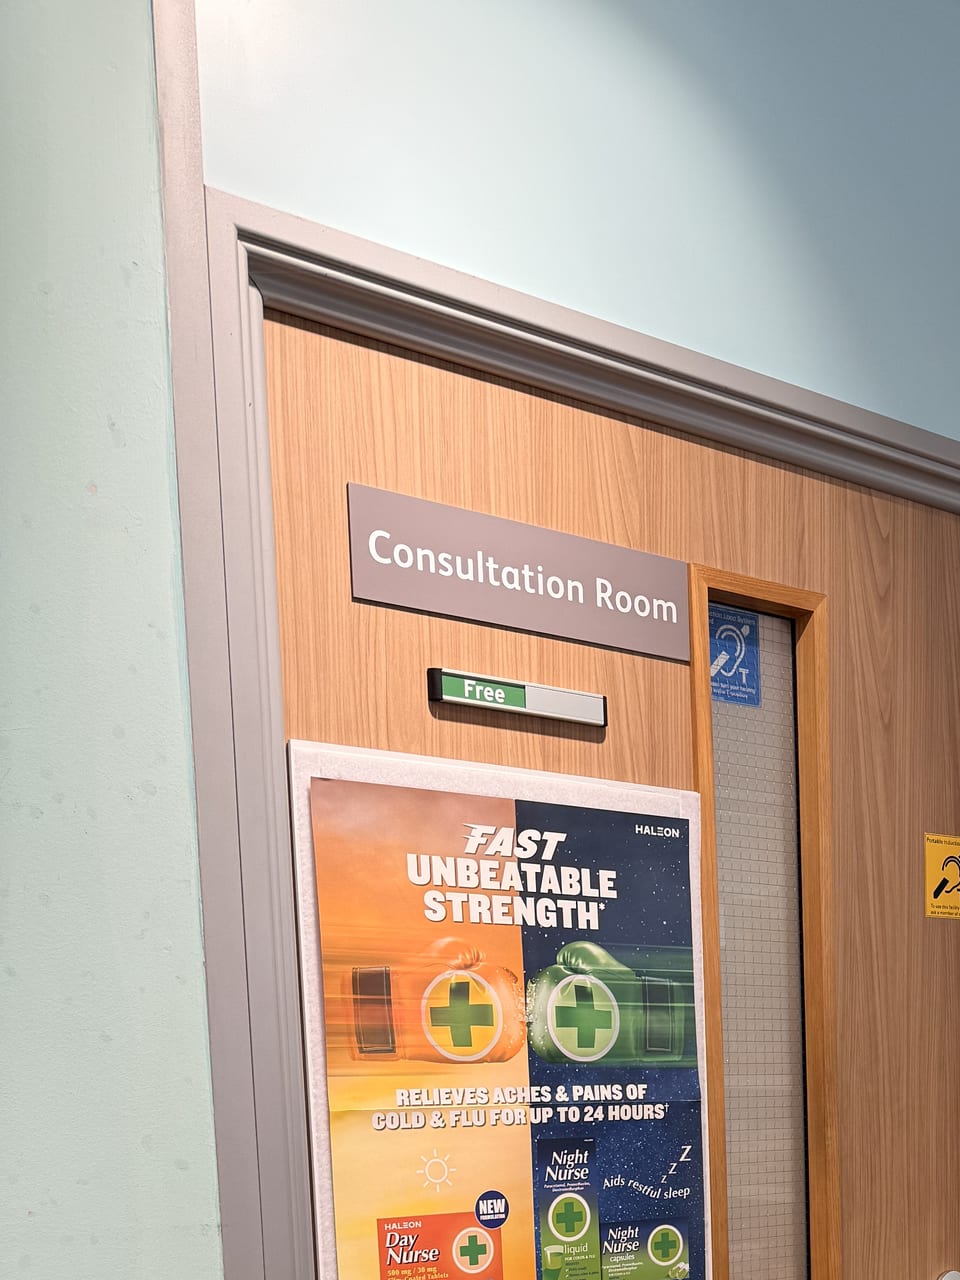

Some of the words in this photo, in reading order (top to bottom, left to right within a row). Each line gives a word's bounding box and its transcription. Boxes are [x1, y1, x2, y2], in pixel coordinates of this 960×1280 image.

[368, 530, 584, 603] Consultation
[596, 578, 677, 623] Room
[464, 679, 505, 703] Free
[635, 824, 680, 838] HALEON
[463, 823, 566, 861] FAST
[407, 854, 618, 898] UNBEATABLE
[395, 1088, 489, 1107] RELIEVES
[493, 1086, 551, 1105] ACHES
[556, 1086, 569, 1102] &
[573, 1085, 622, 1101] PAINS
[626, 1084, 648, 1100] OF
[372, 1111, 426, 1130] COLD
[430, 1110, 447, 1128] &
[450, 1110, 485, 1127] FLU
[491, 1109, 527, 1126] FOR
[531, 1107, 553, 1124] UP
[557, 1106, 579, 1123] TO
[584, 1106, 604, 1122] 24
[552, 1149, 589, 1169] Night
[545, 1166, 589, 1181] Nurse
[603, 1174, 625, 1189] Aids
[628, 1179, 661, 1199] restful
[664, 1187, 690, 1199] sleep
[479, 1199, 505, 1214] NEW
[385, 1221, 421, 1230] HALEON
[386, 1232, 418, 1250] Day
[608, 1226, 639, 1243] Night
[564, 1243, 588, 1257] liquid
[603, 1240, 640, 1255] Nurse
[387, 1248, 439, 1265] Nurse
[610, 1253, 635, 1262] capsules
[428, 1272, 448, 1280] Tablets
